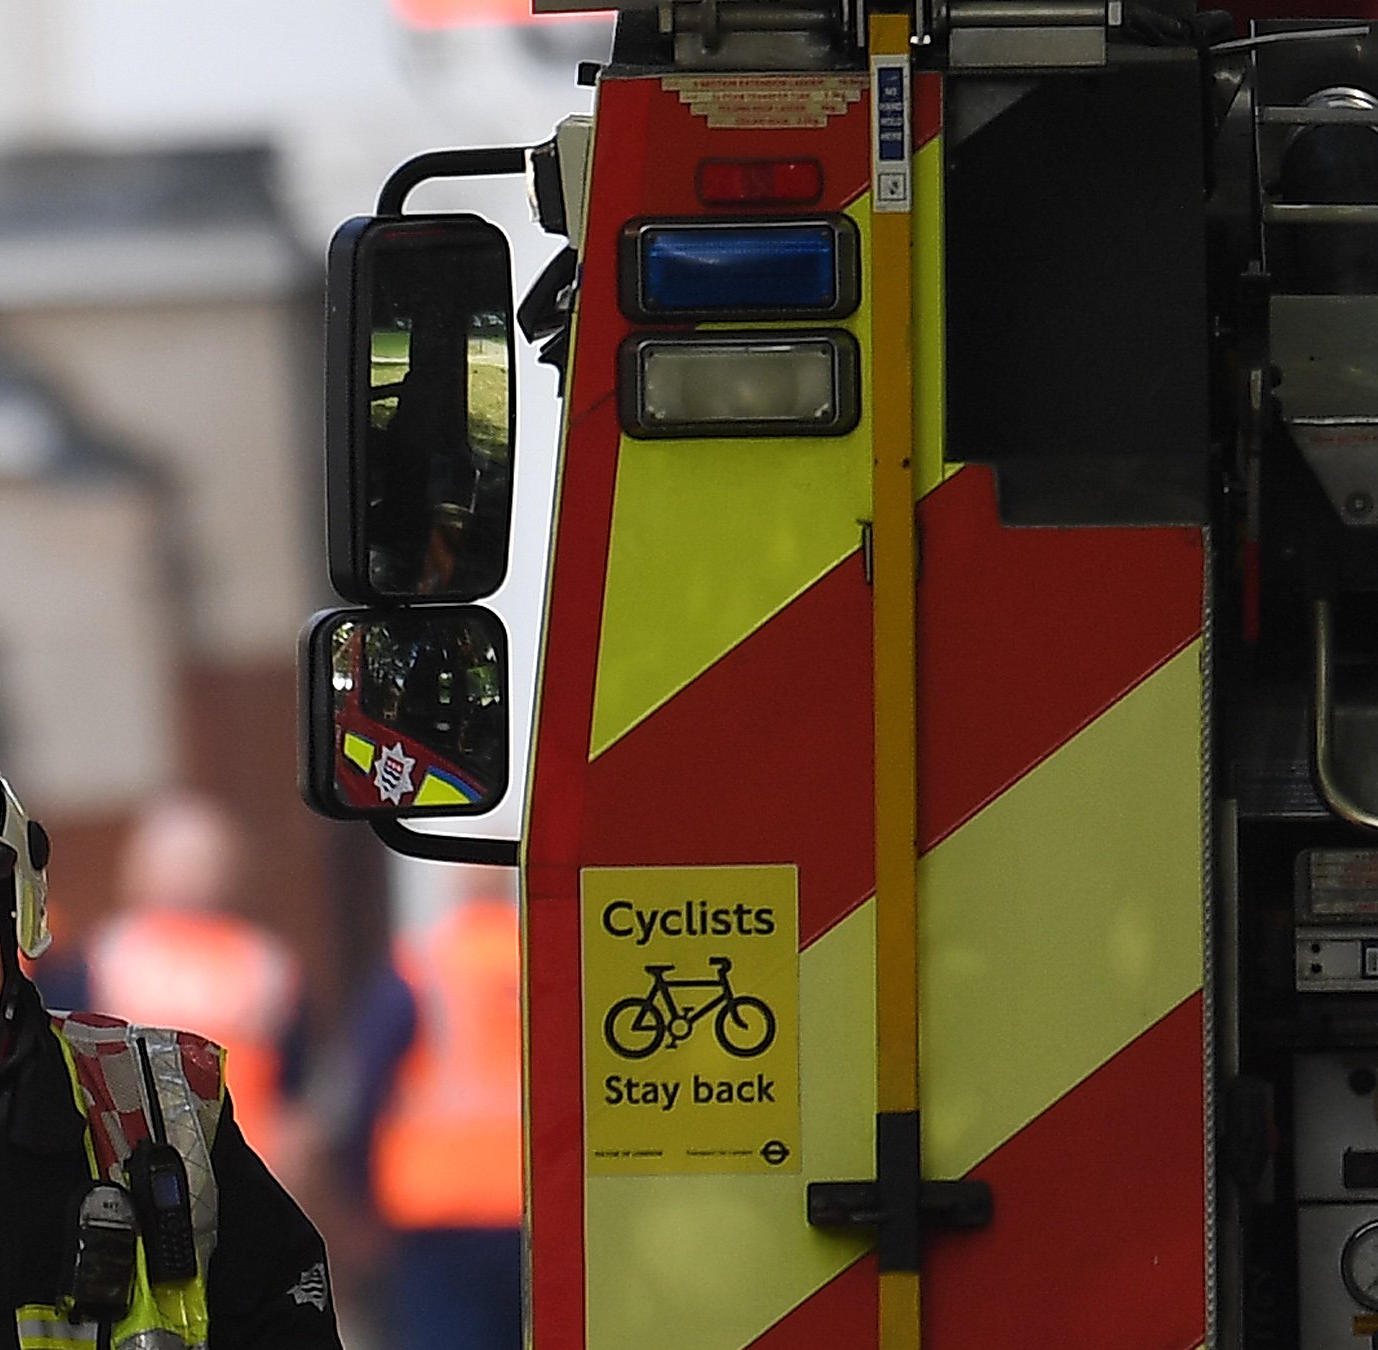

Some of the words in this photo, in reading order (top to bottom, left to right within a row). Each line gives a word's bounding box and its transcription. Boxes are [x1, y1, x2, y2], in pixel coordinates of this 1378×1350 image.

[602, 900, 775, 944] Cyclists
[605, 1075, 679, 1110] Stay
[693, 1074, 775, 1104] back
